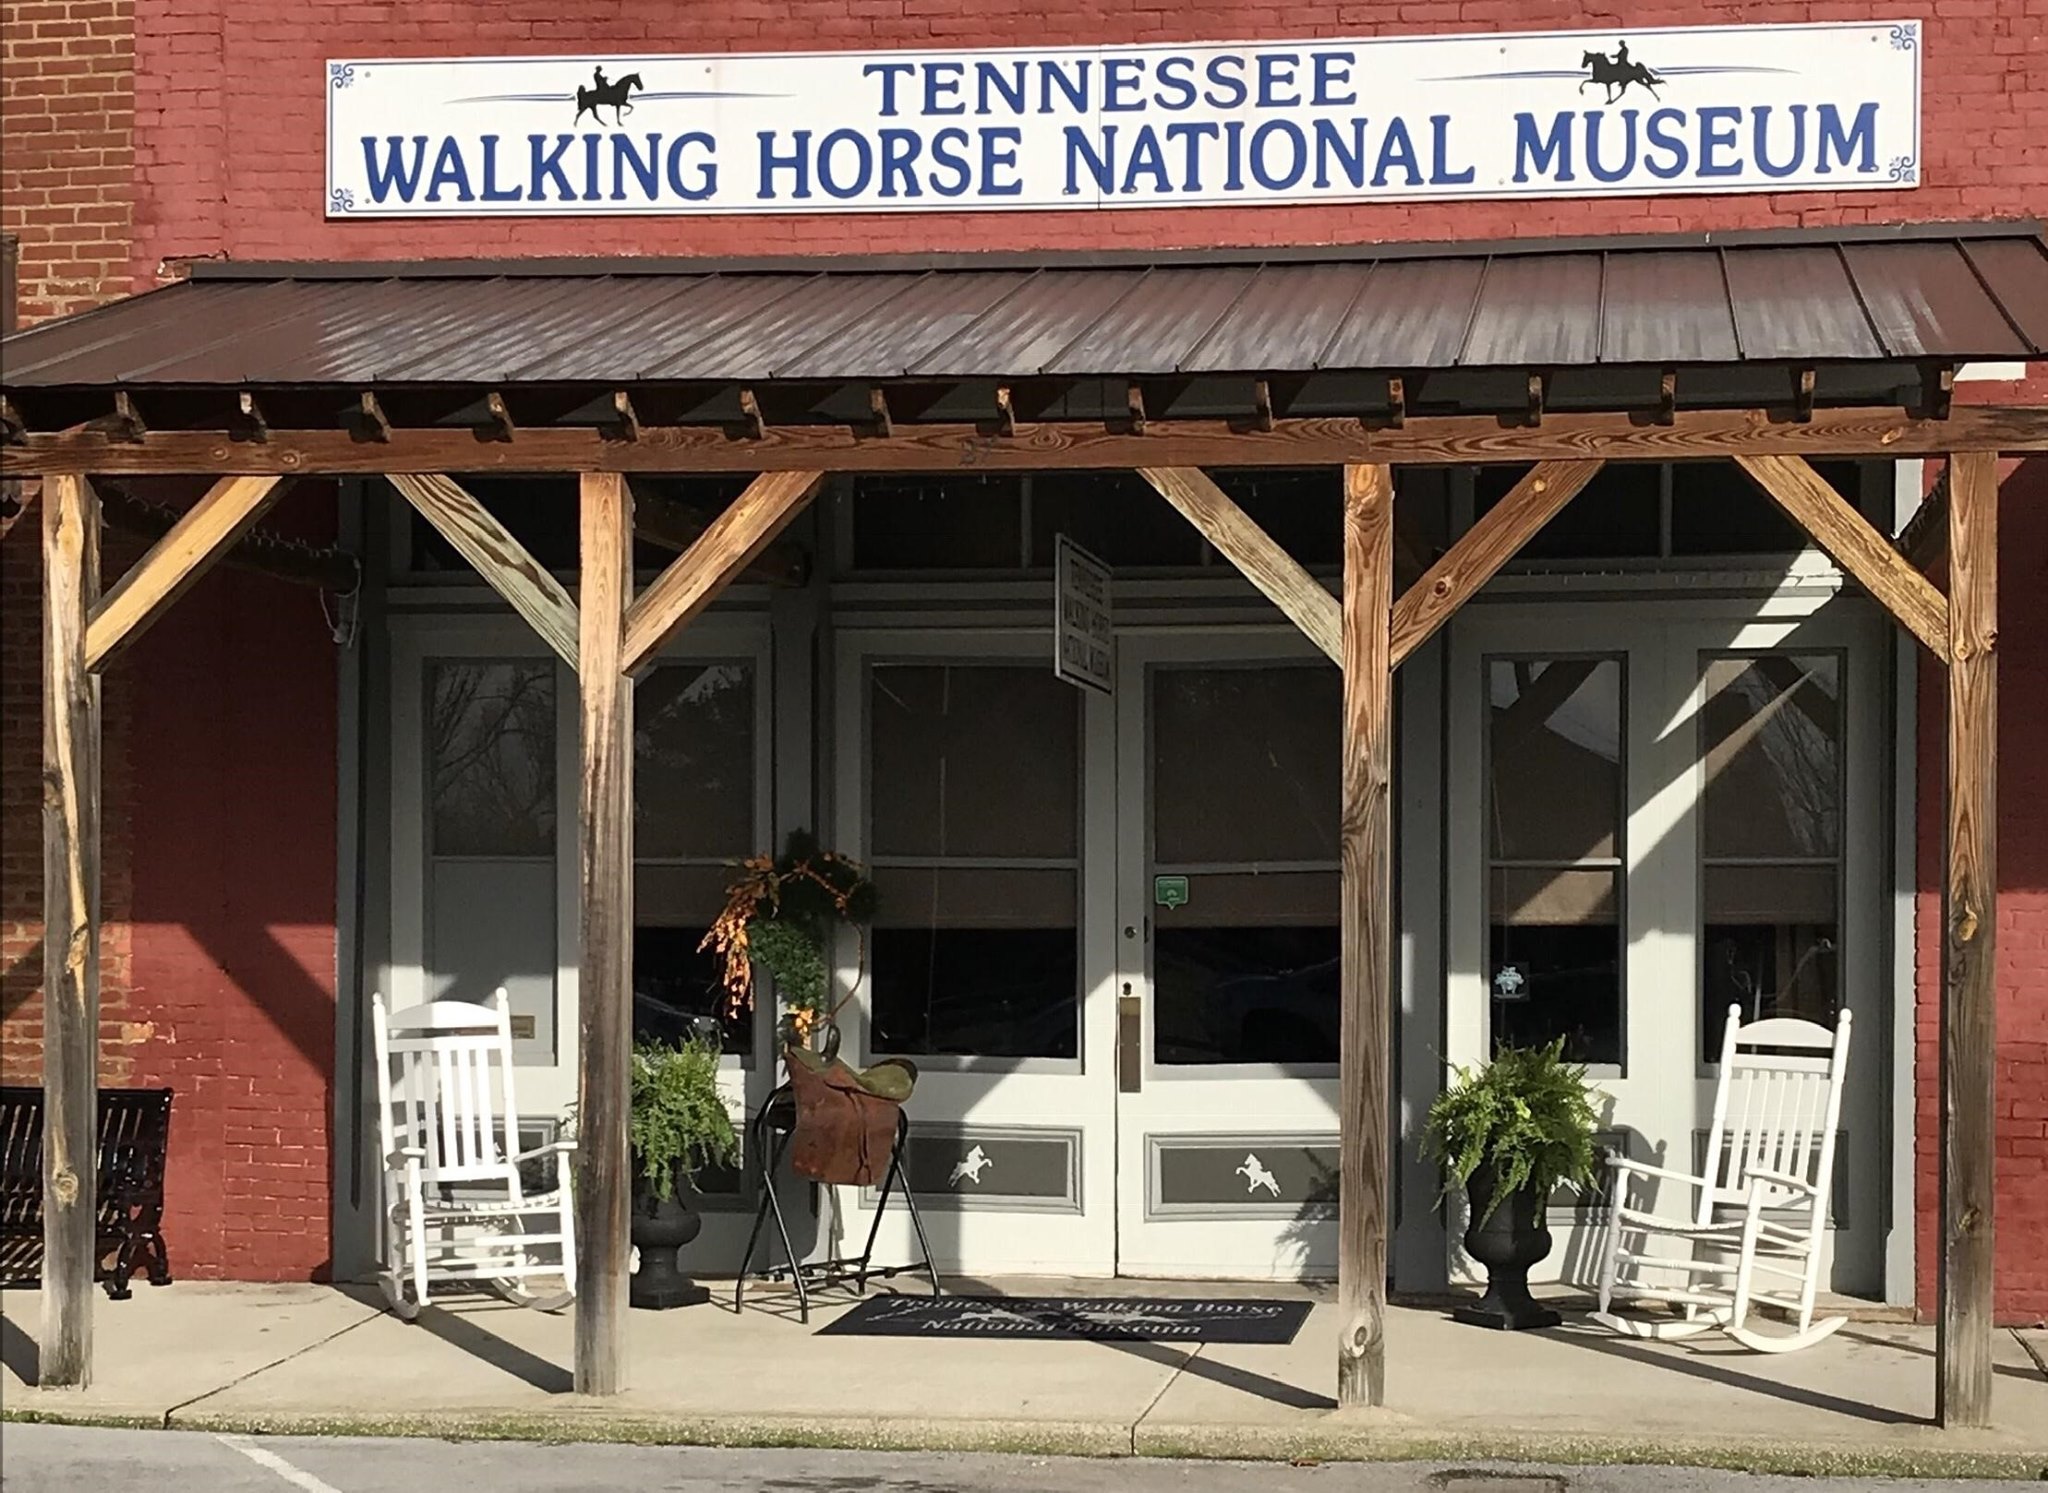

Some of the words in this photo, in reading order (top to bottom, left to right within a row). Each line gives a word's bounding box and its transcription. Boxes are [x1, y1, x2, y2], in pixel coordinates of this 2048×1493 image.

[866, 53, 1353, 116] TENNESSEE
[362, 132, 716, 201] WALKING
[759, 127, 1021, 198] HORSE
[1066, 115, 1474, 193] NATIONAL
[1515, 103, 1877, 182] MUSEUM
[920, 1319, 1057, 1332] National
[1065, 1321, 1202, 1334] Museum
[1061, 1300, 1183, 1313] Walking
[1192, 1302, 1284, 1314] Horse
